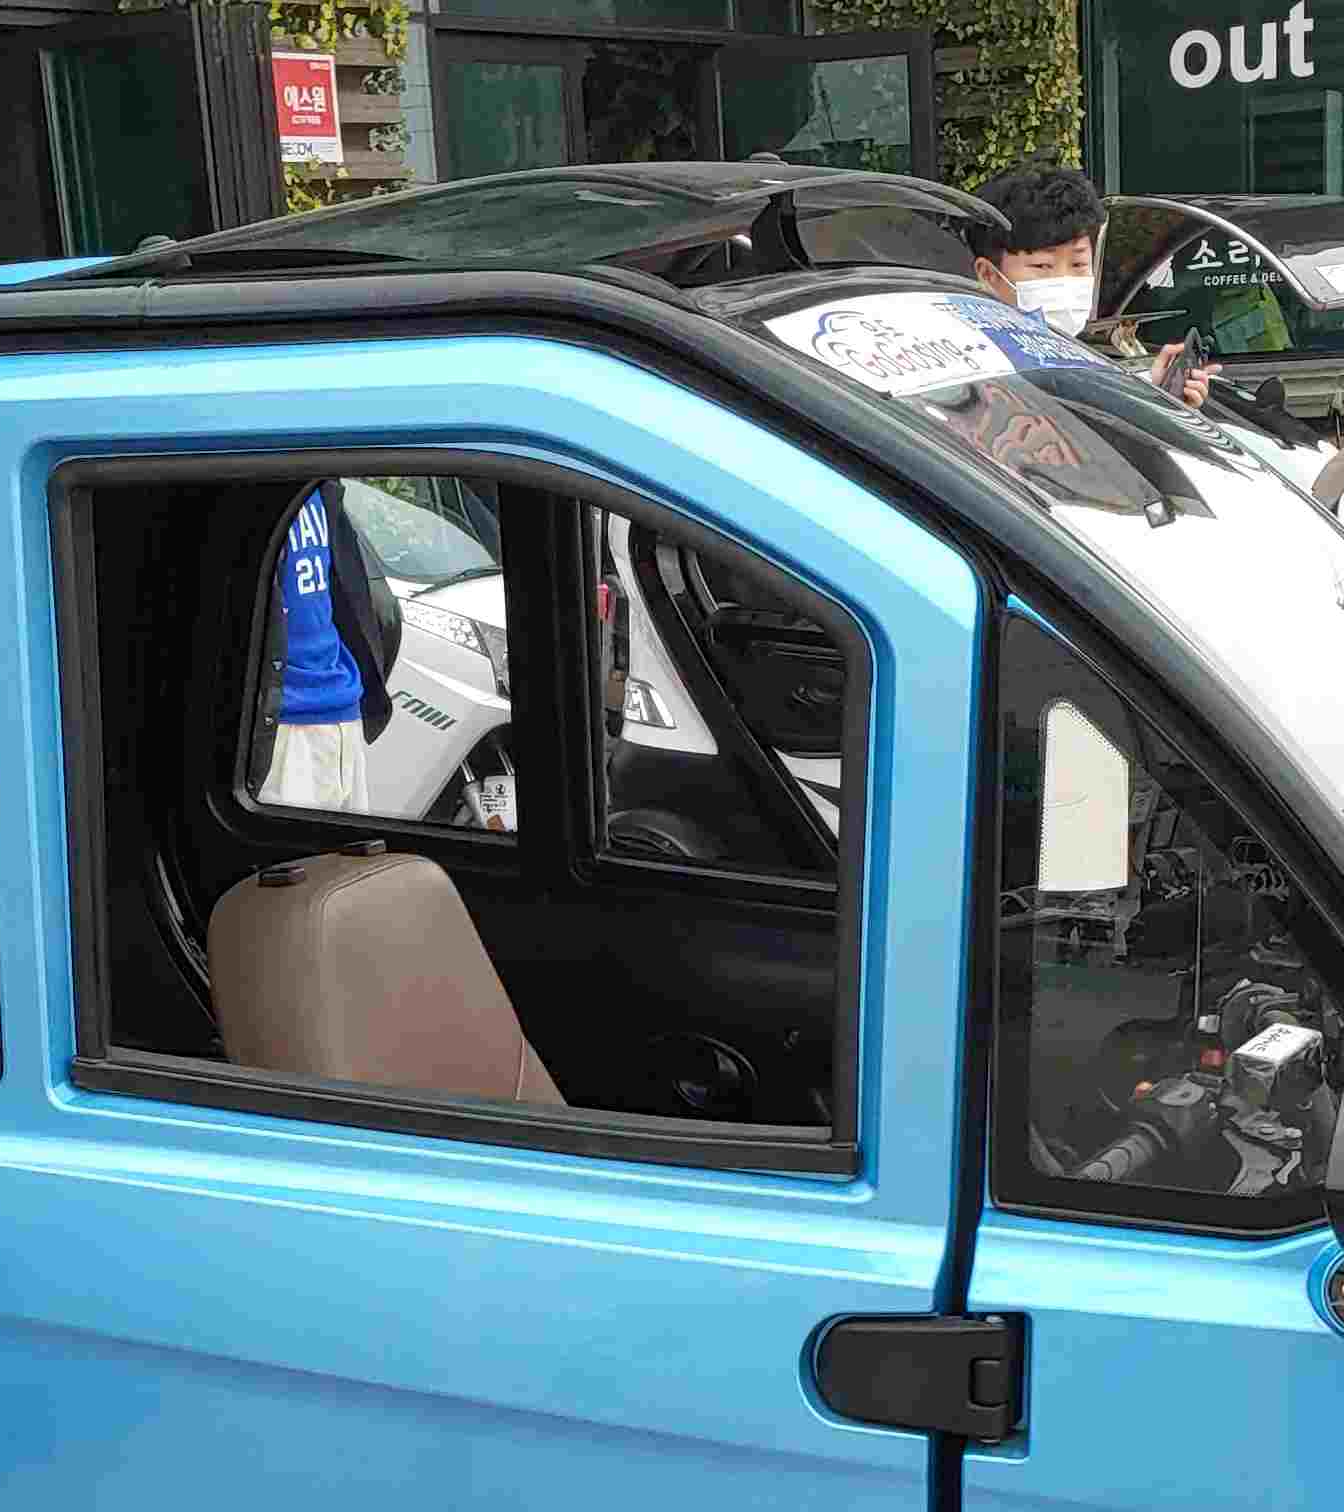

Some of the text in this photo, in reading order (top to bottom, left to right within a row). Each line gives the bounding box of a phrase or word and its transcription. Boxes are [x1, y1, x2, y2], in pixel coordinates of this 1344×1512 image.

[1169, 0, 1314, 88] out
[1204, 273, 1247, 286] COFFEE
[295, 555, 327, 595] 21
